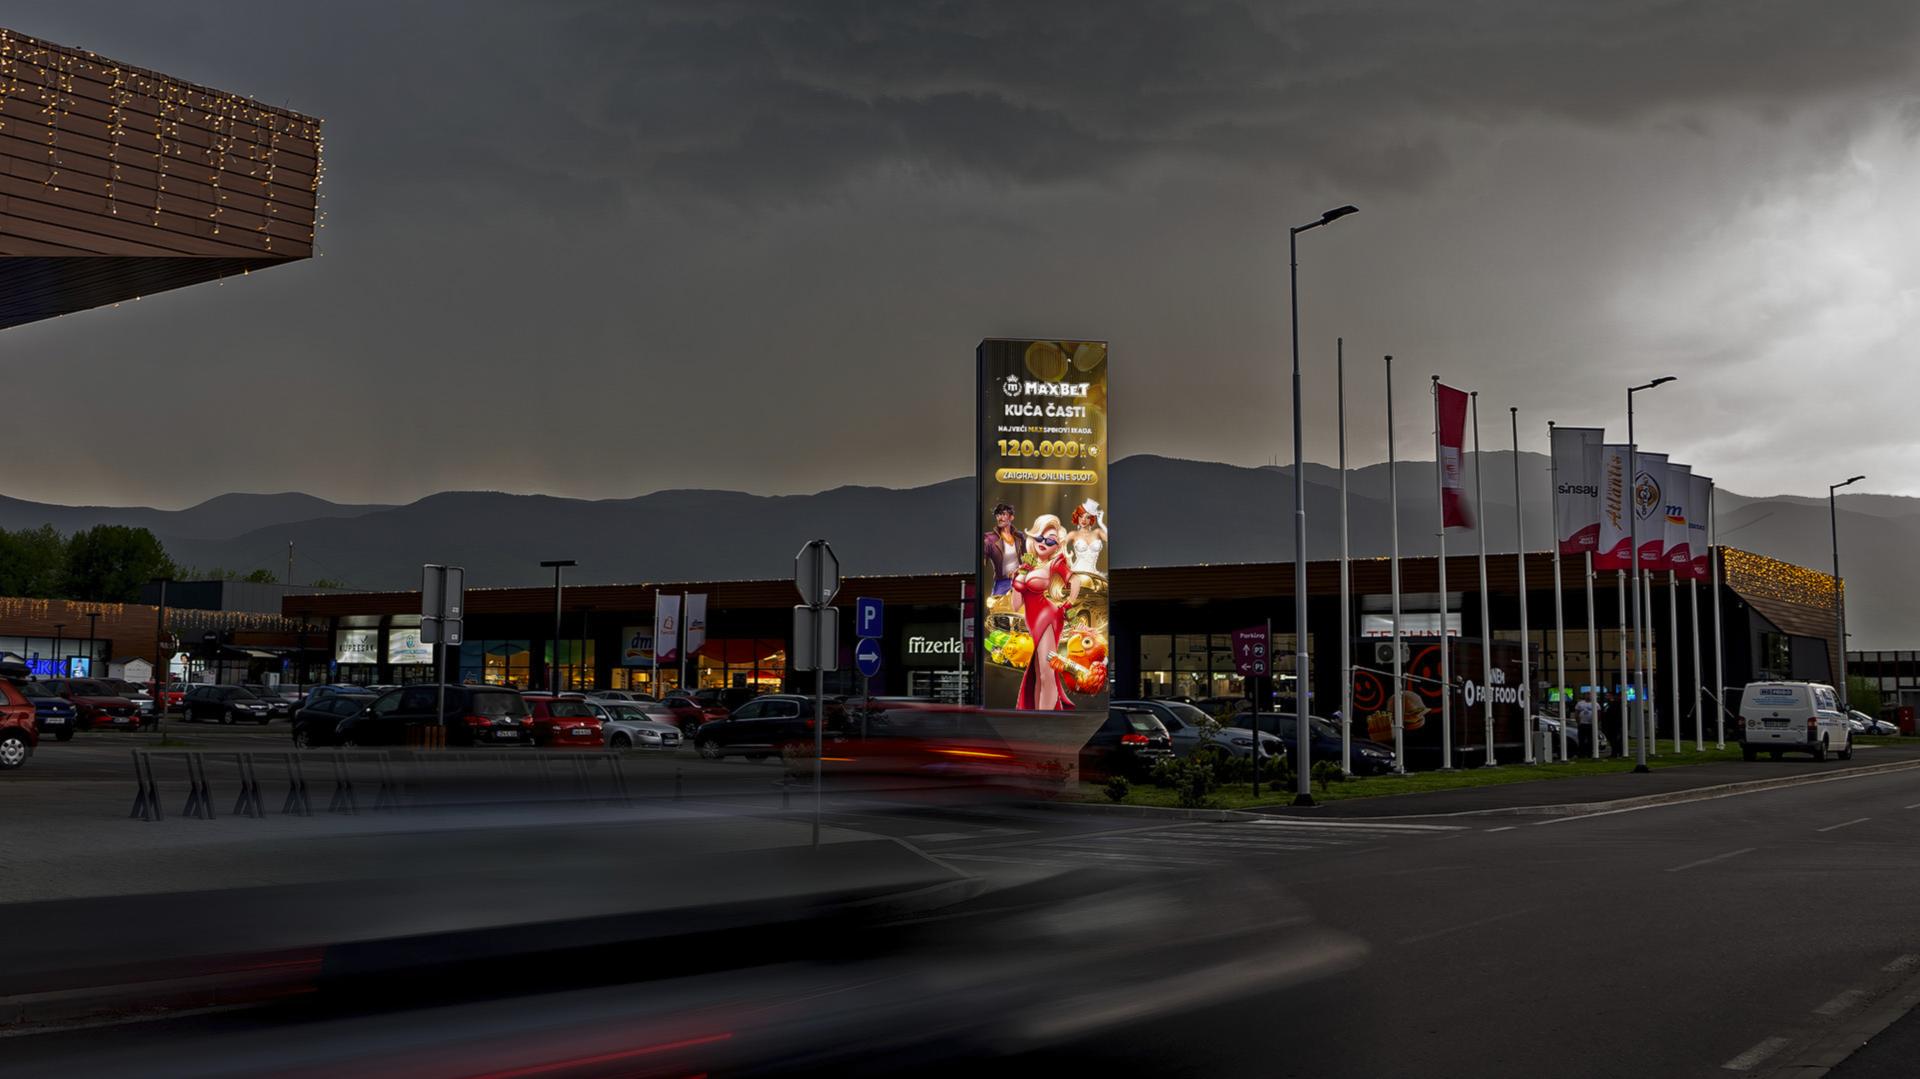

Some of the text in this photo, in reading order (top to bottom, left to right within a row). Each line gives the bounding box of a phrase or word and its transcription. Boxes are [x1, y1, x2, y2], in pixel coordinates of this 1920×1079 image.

[1004, 401, 1086, 418] KUĆA ČASTI
[997, 439, 1079, 458] 120.000
[1003, 471, 1092, 481] ZAIGRAJ ONLINE SLOT
[1558, 482, 1598, 498] sinsay
[864, 605, 877, 630] P
[632, 632, 653, 649] dm
[1239, 632, 1265, 640] Parking
[1495, 687, 1516, 704] FOOD
